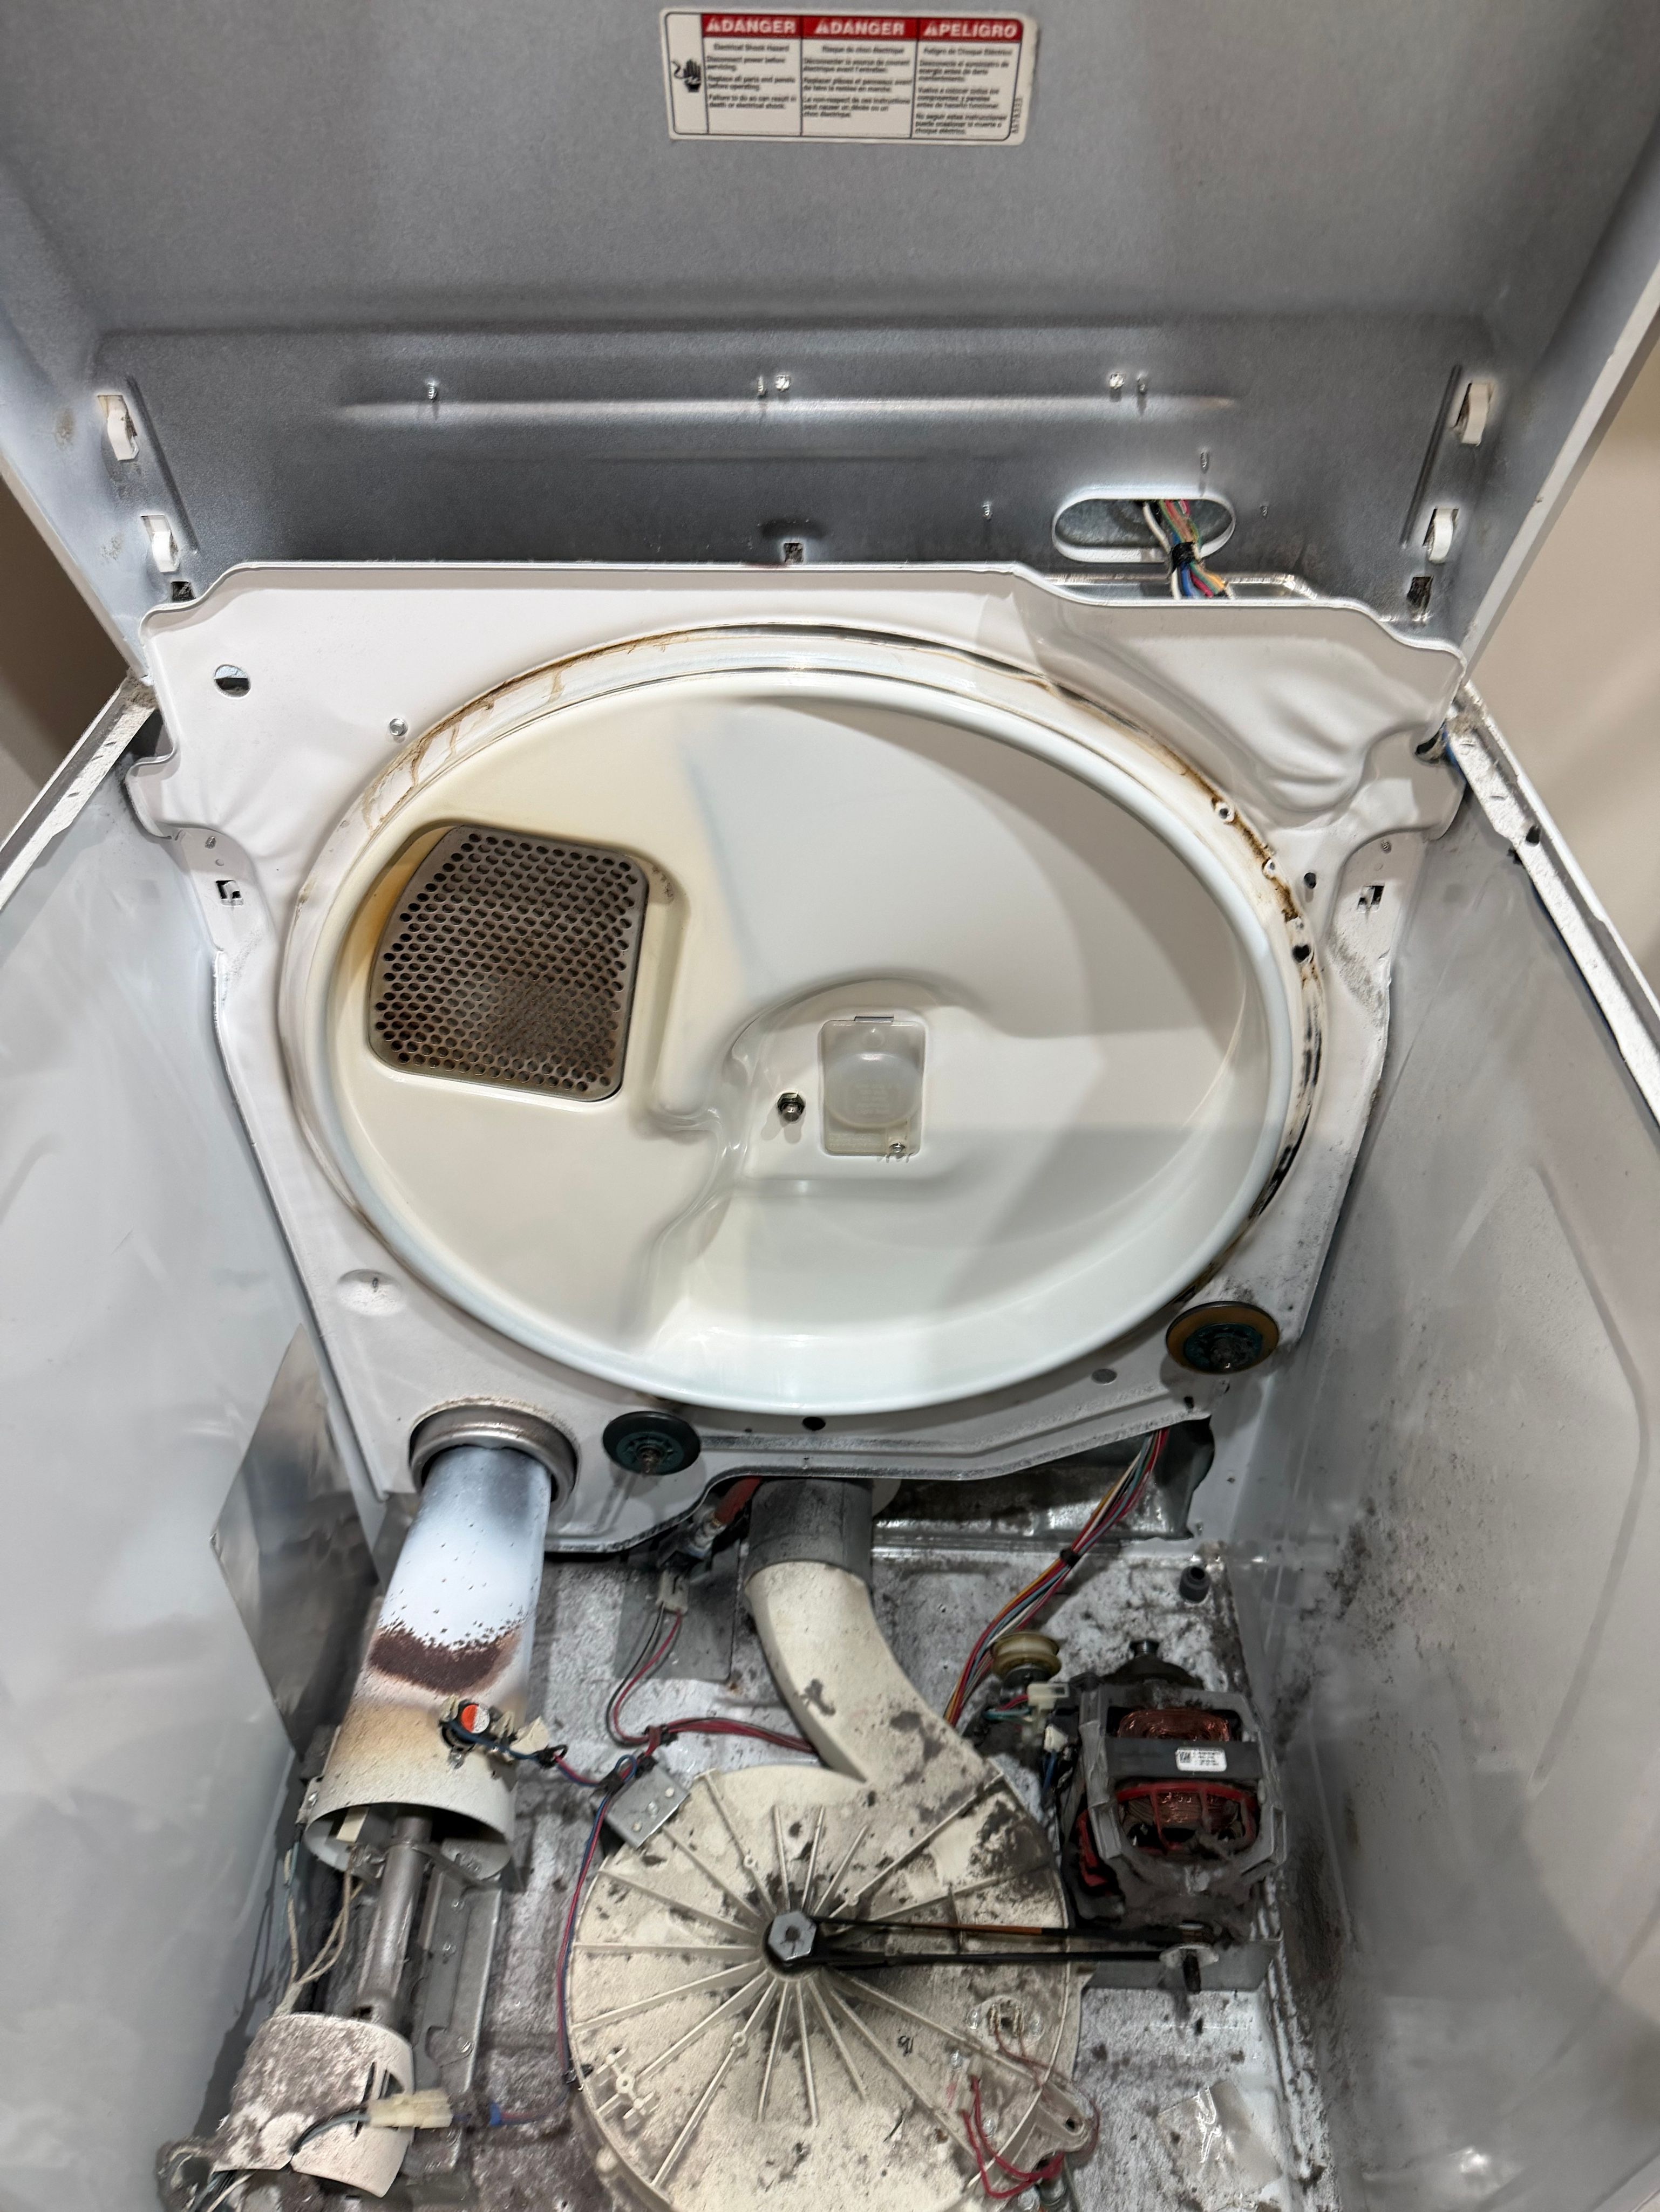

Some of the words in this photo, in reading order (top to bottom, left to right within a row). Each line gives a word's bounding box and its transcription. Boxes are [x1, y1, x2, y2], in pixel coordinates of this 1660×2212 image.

[722, 19, 797, 33] DANGER
[830, 21, 904, 36] DANGER
[938, 23, 1018, 38] PELIGRO
